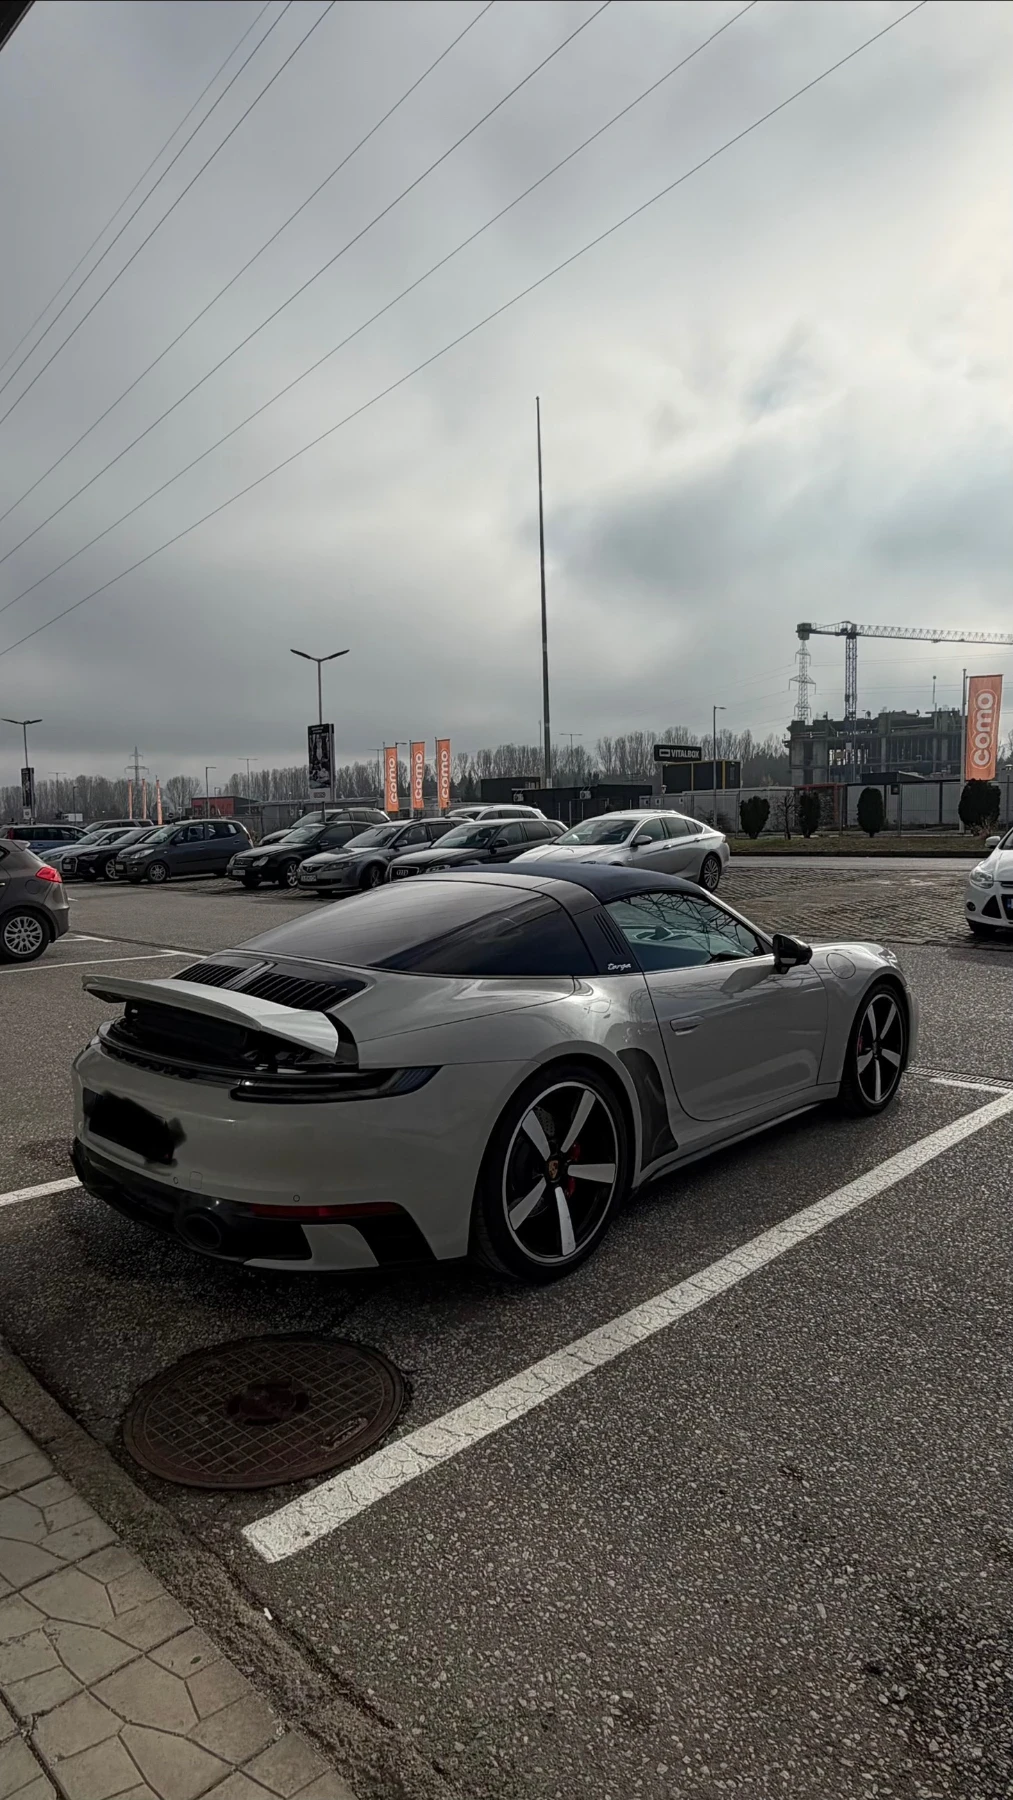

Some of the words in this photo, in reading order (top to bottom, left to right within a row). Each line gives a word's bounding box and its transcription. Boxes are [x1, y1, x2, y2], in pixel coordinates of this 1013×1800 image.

[973, 692, 994, 766] como
[414, 753, 423, 800] como
[440, 750, 449, 799] como
[671, 749, 700, 759] VITALBOX
[388, 757, 398, 803] como
